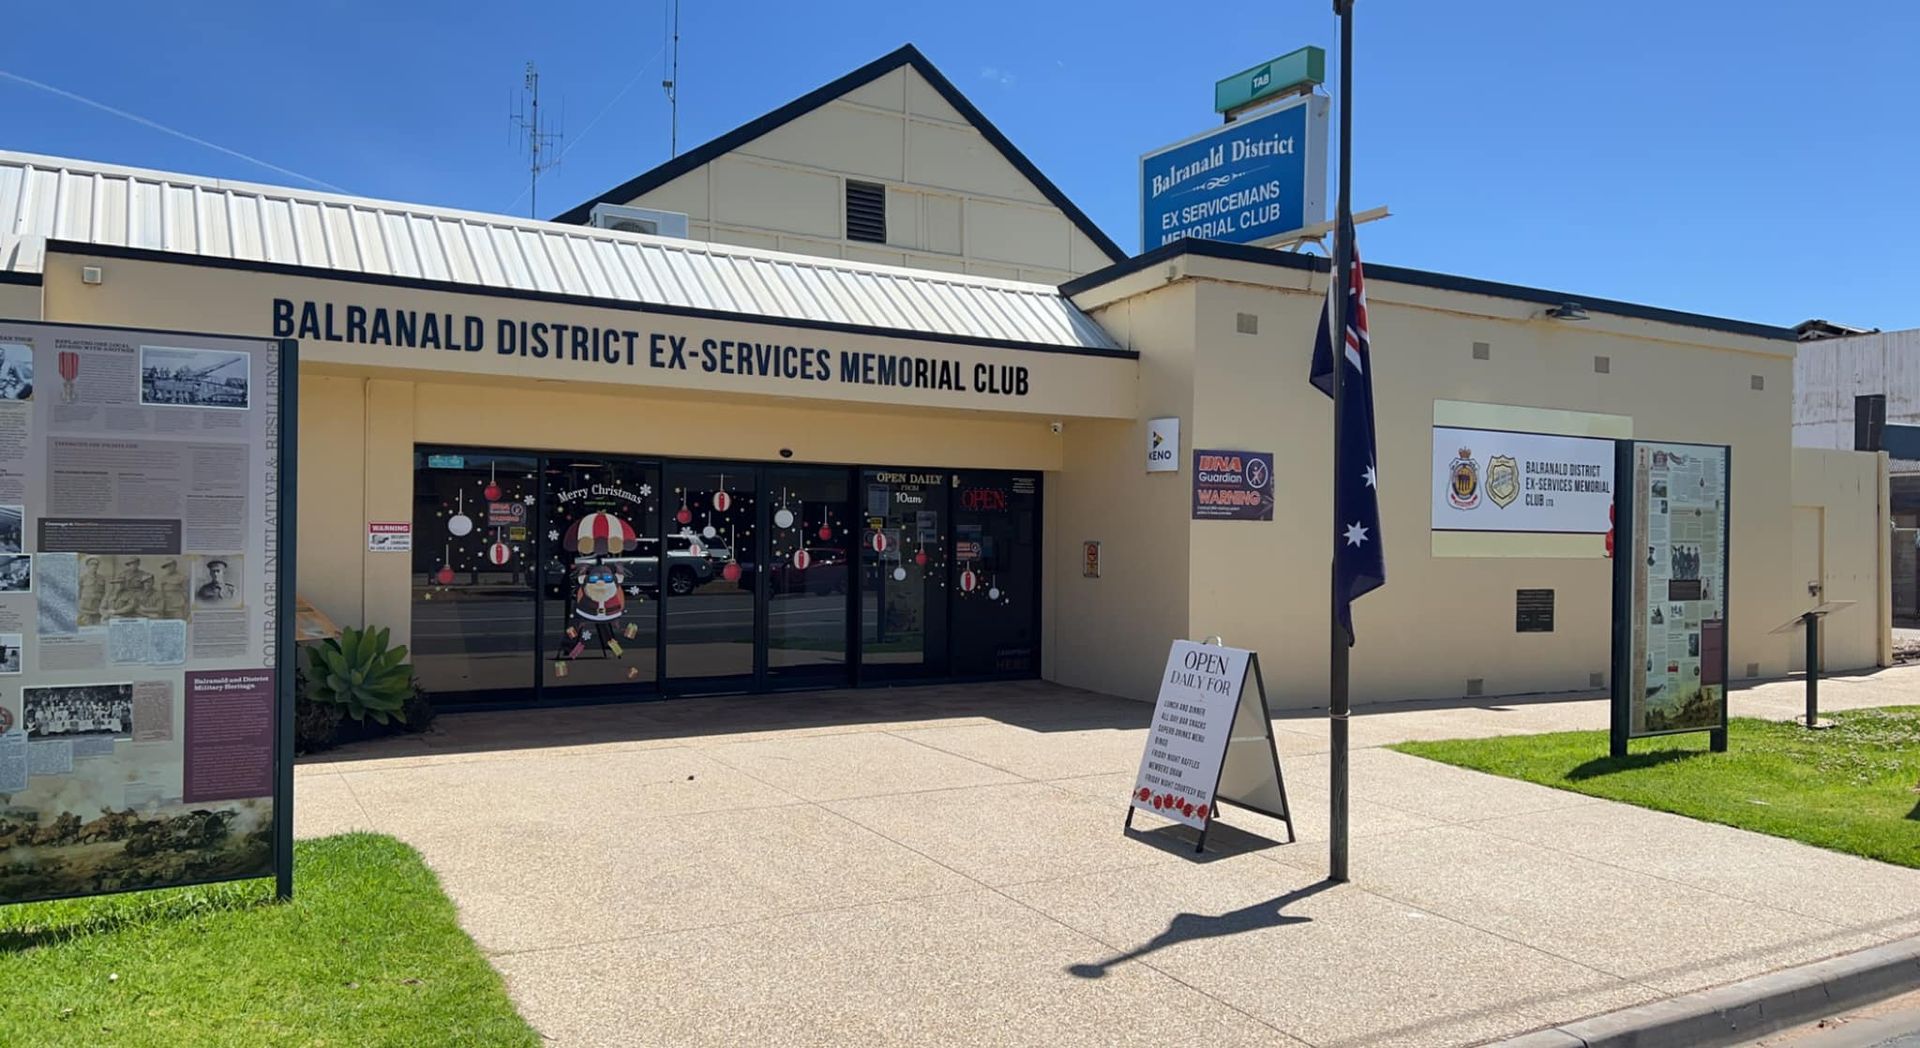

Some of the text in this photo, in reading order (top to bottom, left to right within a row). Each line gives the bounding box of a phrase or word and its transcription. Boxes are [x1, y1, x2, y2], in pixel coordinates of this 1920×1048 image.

[1253, 74, 1269, 88] TAB
[1152, 134, 1294, 198] Balranald District
[1162, 180, 1280, 230] EX SERVICEMANS
[1240, 203, 1280, 228] CLUB
[273, 298, 1029, 396] BALRANALD DISTRICT EX-SERVICES MEMORIAL CLUB
[266, 342, 278, 450] RESILIENCE
[1199, 455, 1242, 471] DNA
[1526, 461, 1600, 477] BALRANALD DISTRICT
[877, 473, 943, 485] OPEN DAILY
[1199, 472, 1242, 484] Guardian
[1525, 477, 1611, 494] EX-SERVICES MEMORIAL
[557, 483, 642, 504] Merry Christmas
[895, 492, 923, 504] 10am
[961, 490, 1005, 509] OPEN
[1198, 490, 1261, 506] WARNING
[1525, 493, 1544, 507] CLUB
[264, 472, 278, 578] INITIATIVE
[263, 583, 276, 668] COURAGE
[1184, 650, 1229, 675] OPEN
[1170, 670, 1231, 696] DAILY FOR
[1163, 700, 1206, 717] LUNCH AND DINNER
[1161, 711, 1206, 730] ALL DAY BAR SNACKS
[1175, 728, 1192, 740] DRINKS
[1192, 733, 1205, 743] MENU
[1181, 757, 1200, 769] RAFFLES
